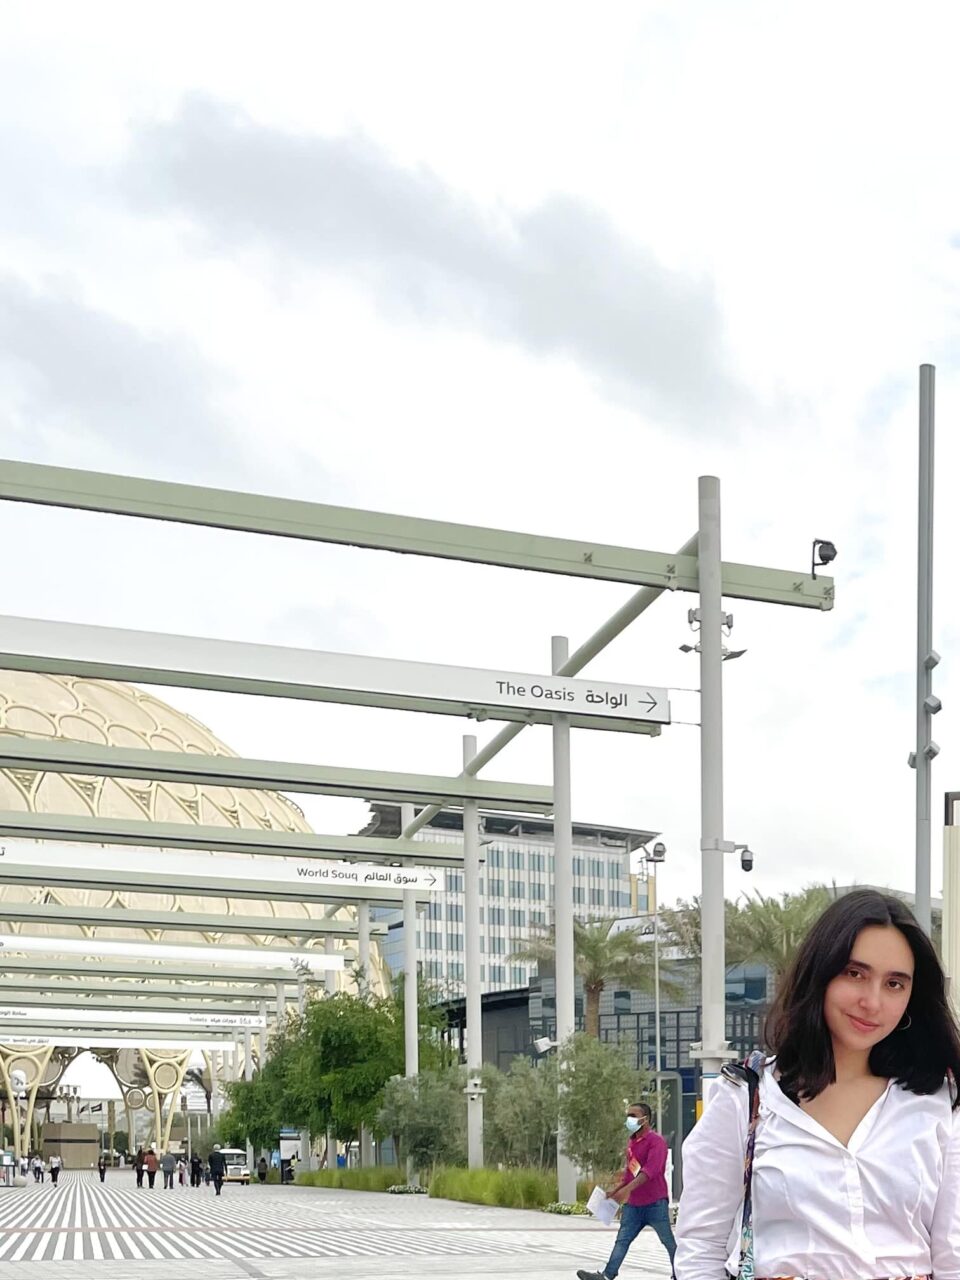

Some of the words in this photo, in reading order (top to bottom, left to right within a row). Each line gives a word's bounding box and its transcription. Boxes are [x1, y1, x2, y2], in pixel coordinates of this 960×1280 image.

[496, 681, 526, 696] The
[531, 685, 575, 702] Oasis
[585, 690, 628, 708] الواحة
[297, 867, 329, 878] World
[331, 869, 358, 882] Souq
[364, 872, 391, 883] العالم
[393, 873, 418, 884] سوق
